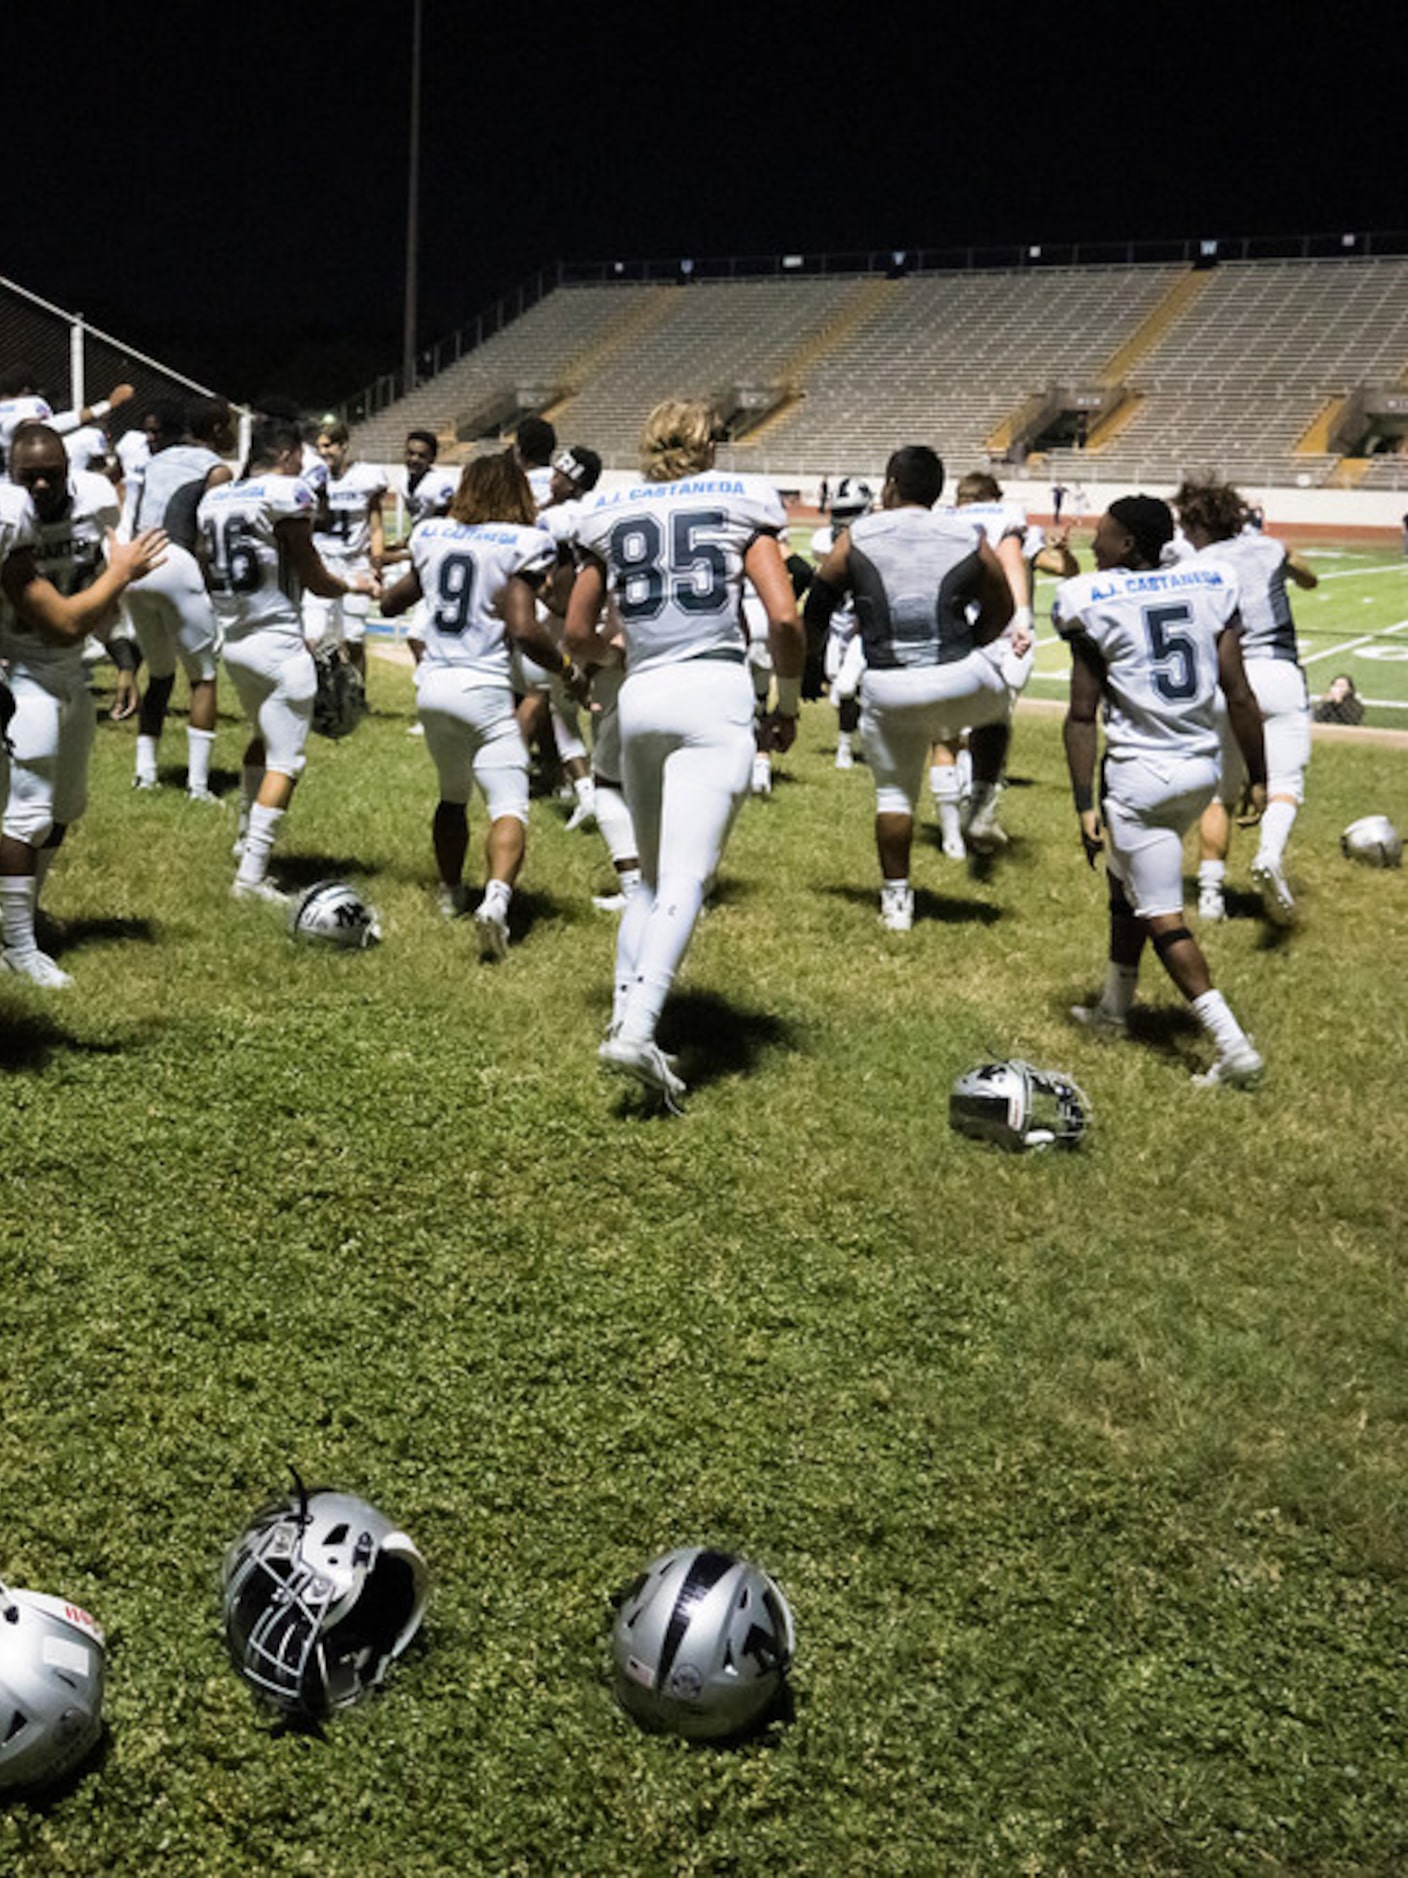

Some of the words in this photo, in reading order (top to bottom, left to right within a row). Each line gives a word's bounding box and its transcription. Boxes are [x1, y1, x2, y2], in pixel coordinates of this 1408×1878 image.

[629, 480, 746, 501] CASTANEDA
[434, 551, 475, 635] 9
[608, 507, 729, 623] 85
[1143, 601, 1199, 704] 5
